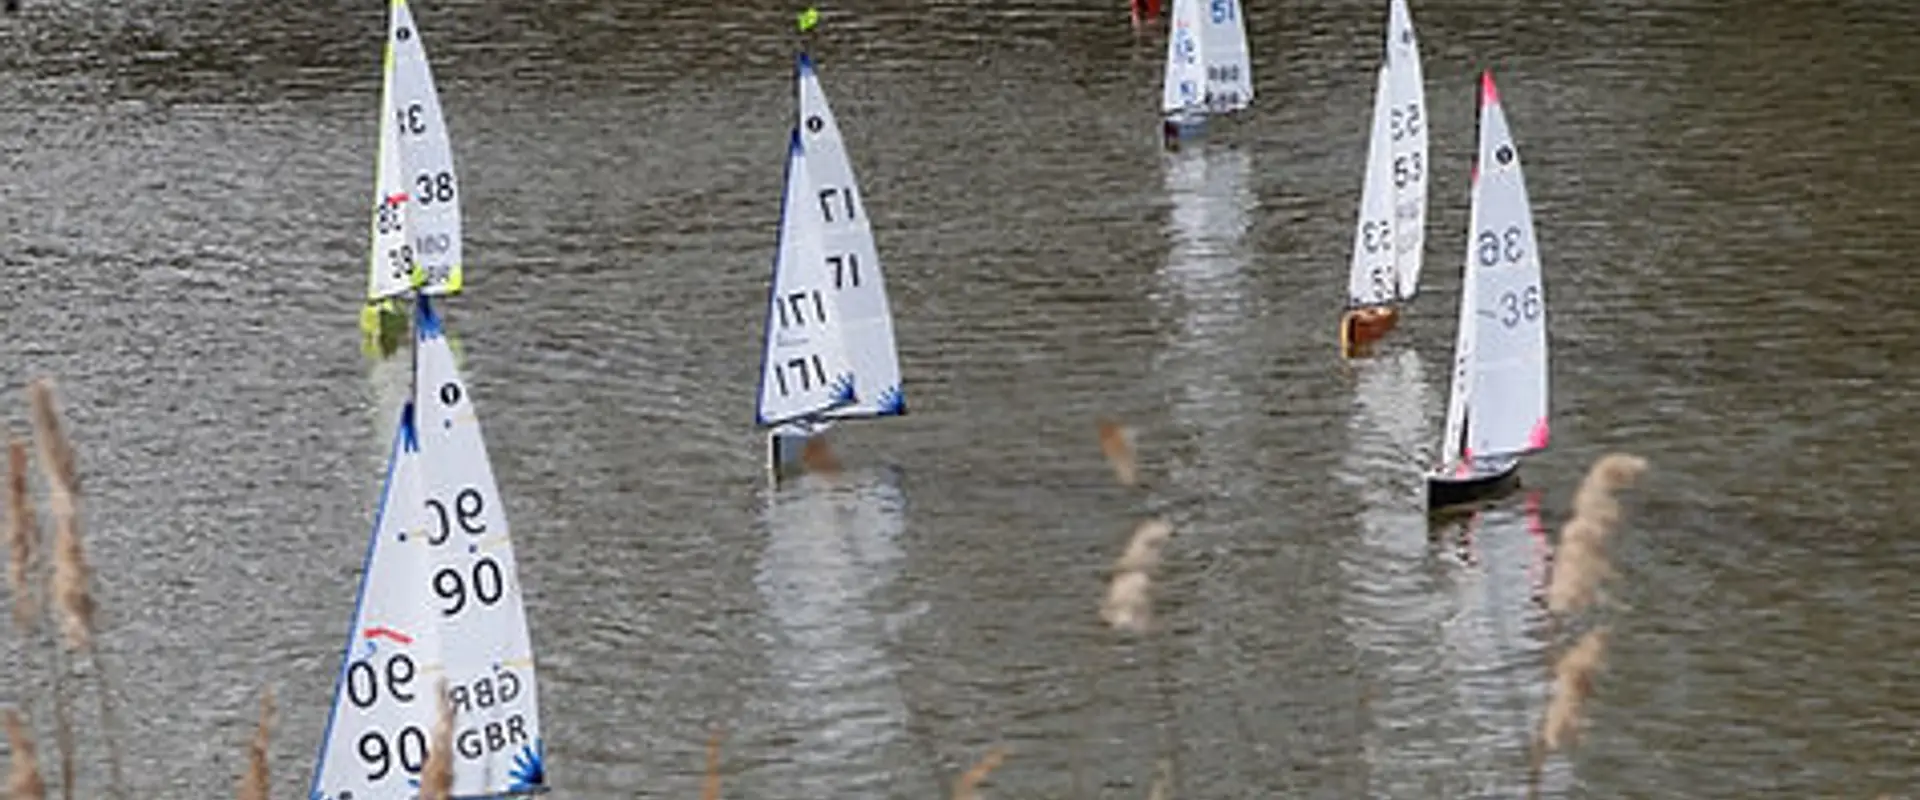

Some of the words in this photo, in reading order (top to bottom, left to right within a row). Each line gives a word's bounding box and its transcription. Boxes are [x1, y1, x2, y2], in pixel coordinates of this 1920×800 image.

[415, 171, 454, 205] 38
[825, 253, 860, 290] 71
[1500, 285, 1542, 328] 36
[775, 354, 828, 397] 171
[432, 557, 504, 616] 90
[358, 726, 428, 781] 90
[457, 713, 528, 760] GBR
